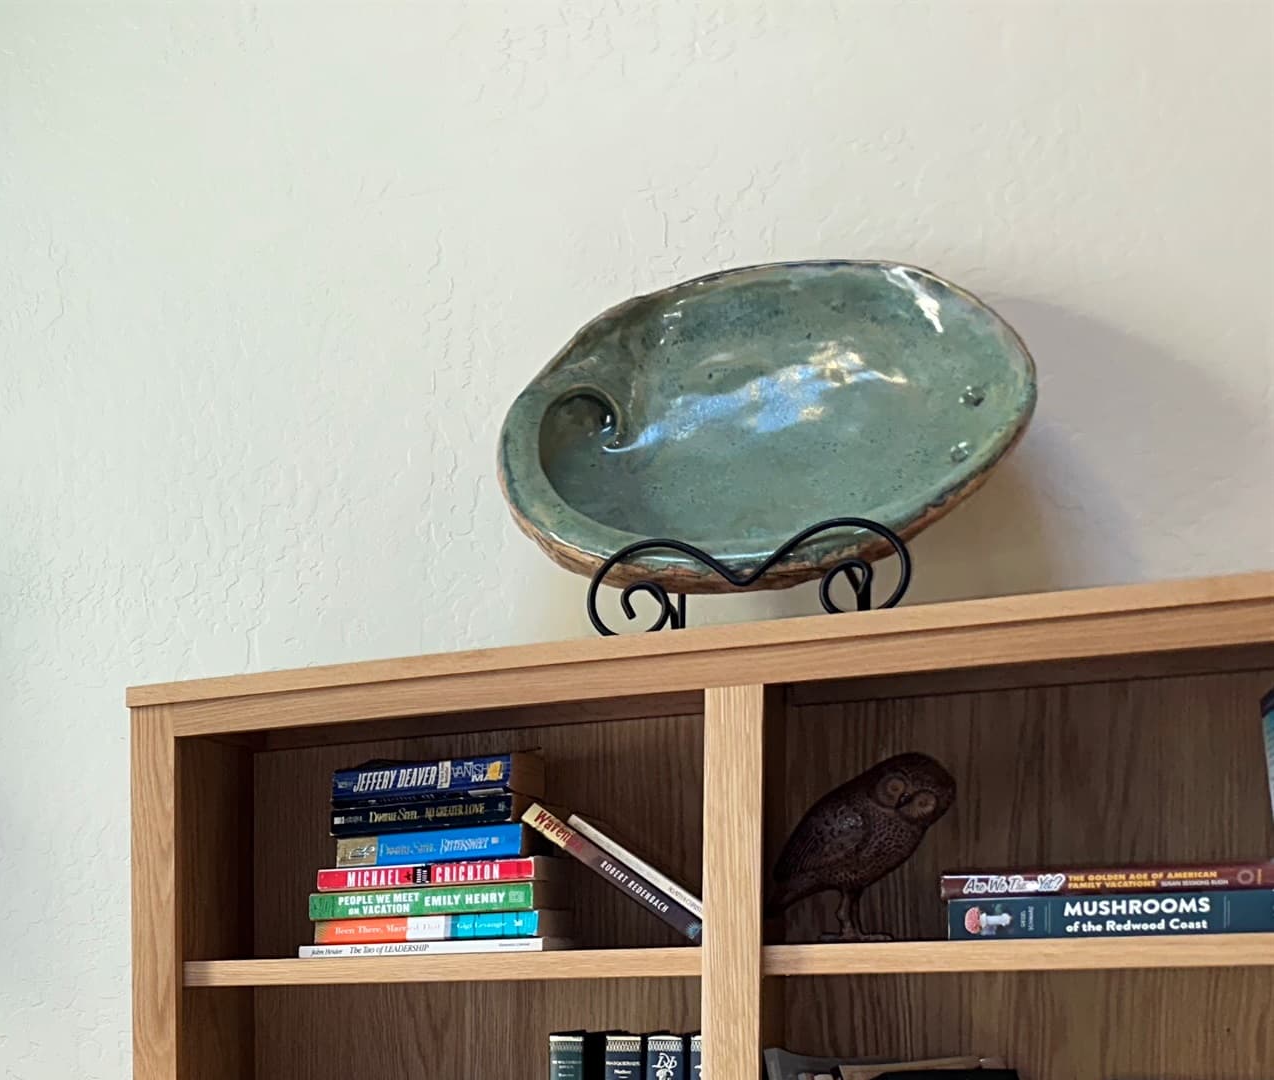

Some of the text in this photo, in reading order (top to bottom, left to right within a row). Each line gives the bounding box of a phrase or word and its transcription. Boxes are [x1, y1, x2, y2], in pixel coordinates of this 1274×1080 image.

[353, 770, 396, 792] JEFFERY
[397, 766, 437, 788] DEAVER
[347, 869, 400, 887] MICHAEL
[436, 864, 500, 882] CRICHTON
[1088, 874, 1126, 882] GOLDEN
[1128, 873, 1150, 881] AGE
[1151, 872, 1164, 880] OF
[1166, 871, 1218, 880] AMERICAN
[600, 860, 628, 884] ROBERT
[627, 880, 670, 914] REDENBACH
[964, 878, 987, 894] Are
[988, 877, 1008, 892] We
[1037, 873, 1066, 891] Yet?
[1069, 882, 1103, 890] FAMILY
[1105, 880, 1158, 889] VACATIONS
[338, 892, 419, 906] PEOPLE WE MEET
[424, 892, 506, 907] EMILY HENRY
[362, 905, 410, 916] VACATION
[1064, 897, 1211, 917] MUSHROOMS
[335, 927, 355, 936] Been
[1066, 917, 1208, 932] of the Redwood Coast
[349, 946, 362, 954] The
[384, 943, 430, 954] LEADERSHIP
